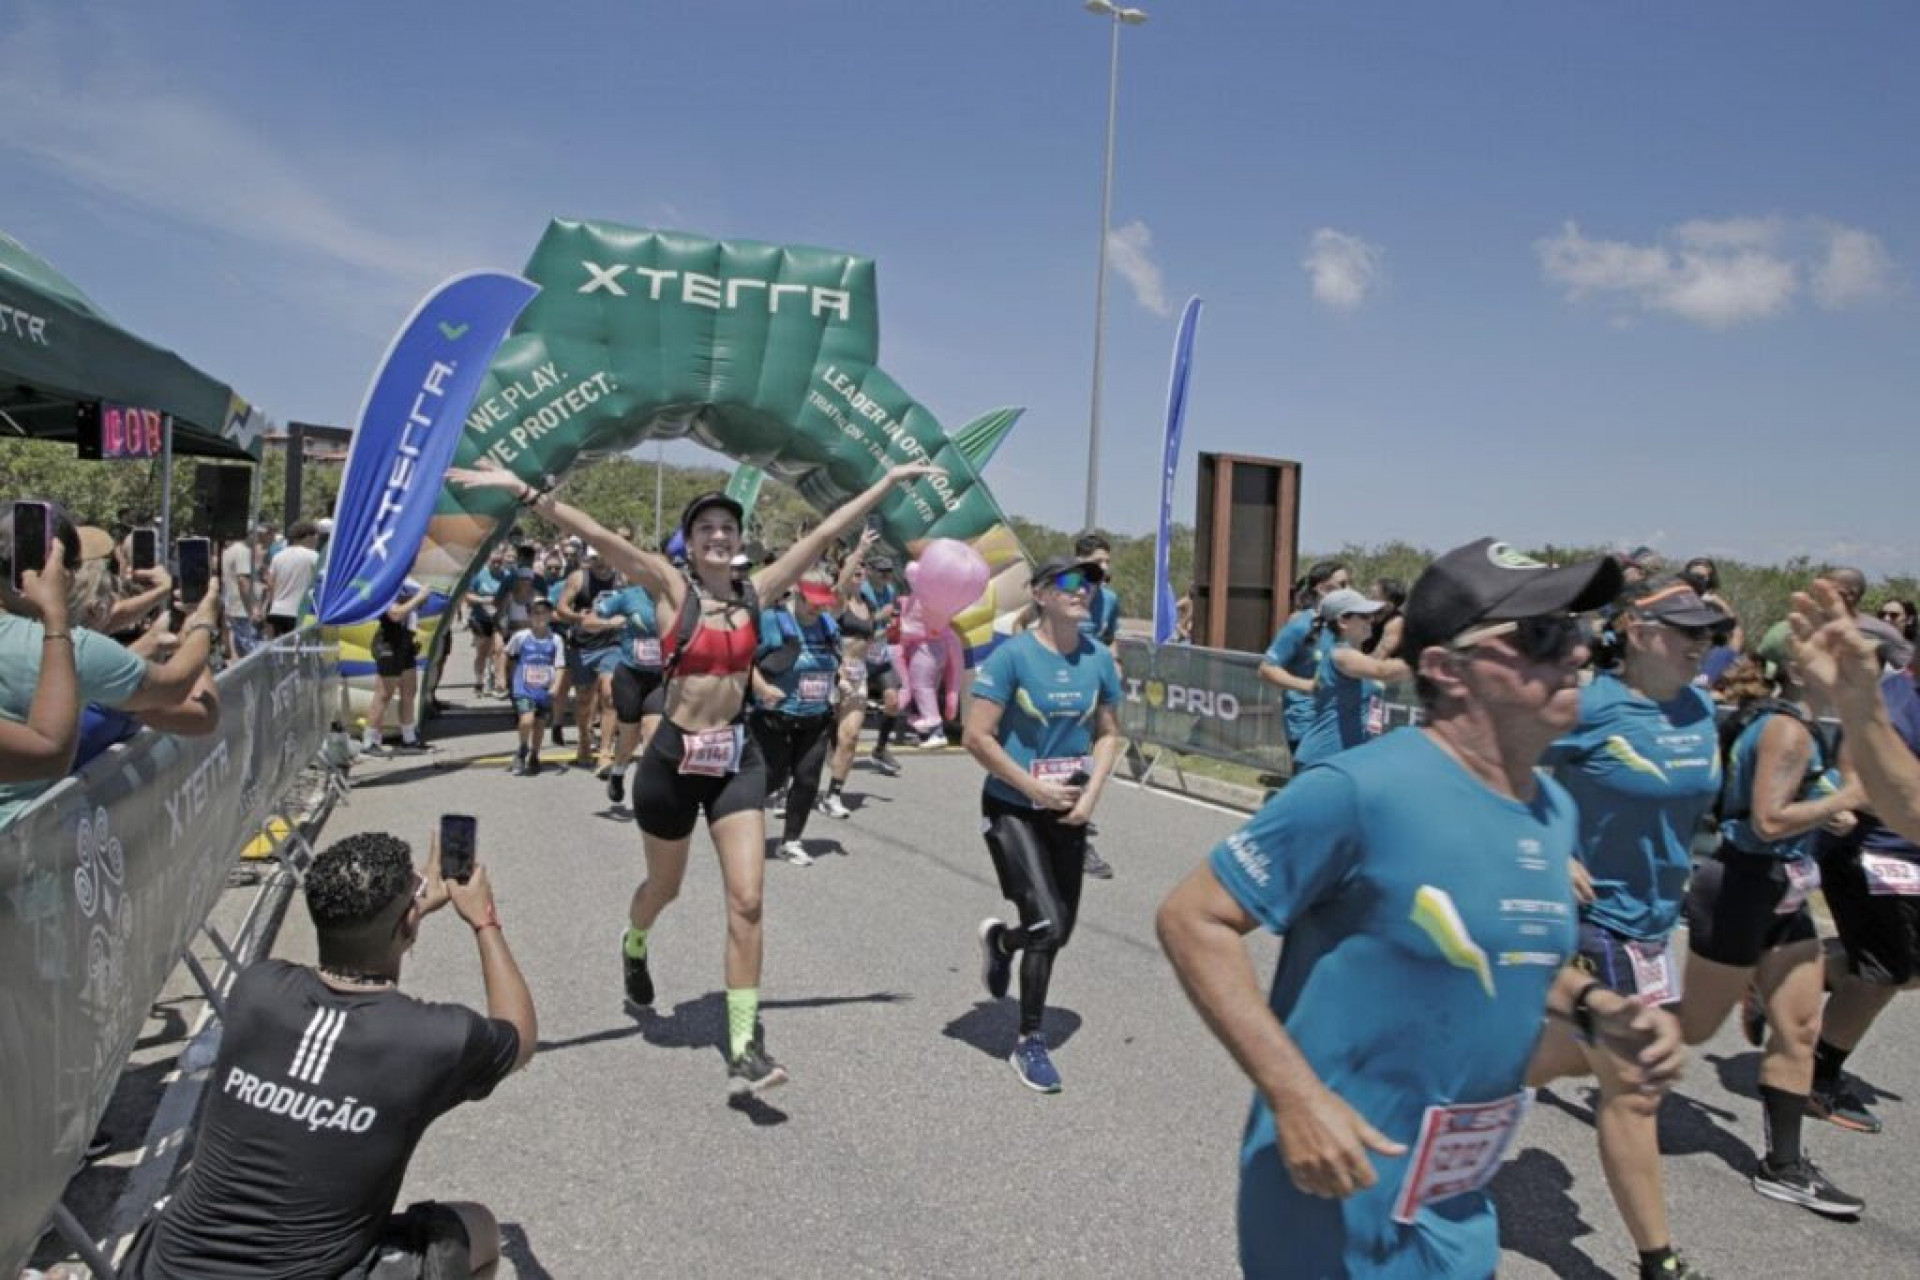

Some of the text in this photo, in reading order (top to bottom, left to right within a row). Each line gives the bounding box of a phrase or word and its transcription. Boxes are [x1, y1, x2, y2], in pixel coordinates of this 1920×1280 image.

[577, 260, 850, 321] XTERRA
[466, 361, 569, 434] WE PLAY.
[509, 371, 618, 449] PROTECT.
[822, 365, 887, 425] LEADER
[367, 361, 455, 561] XTERRA
[1167, 684, 1239, 720] PRIO
[223, 1066, 377, 1133] PRODUÇÃO
